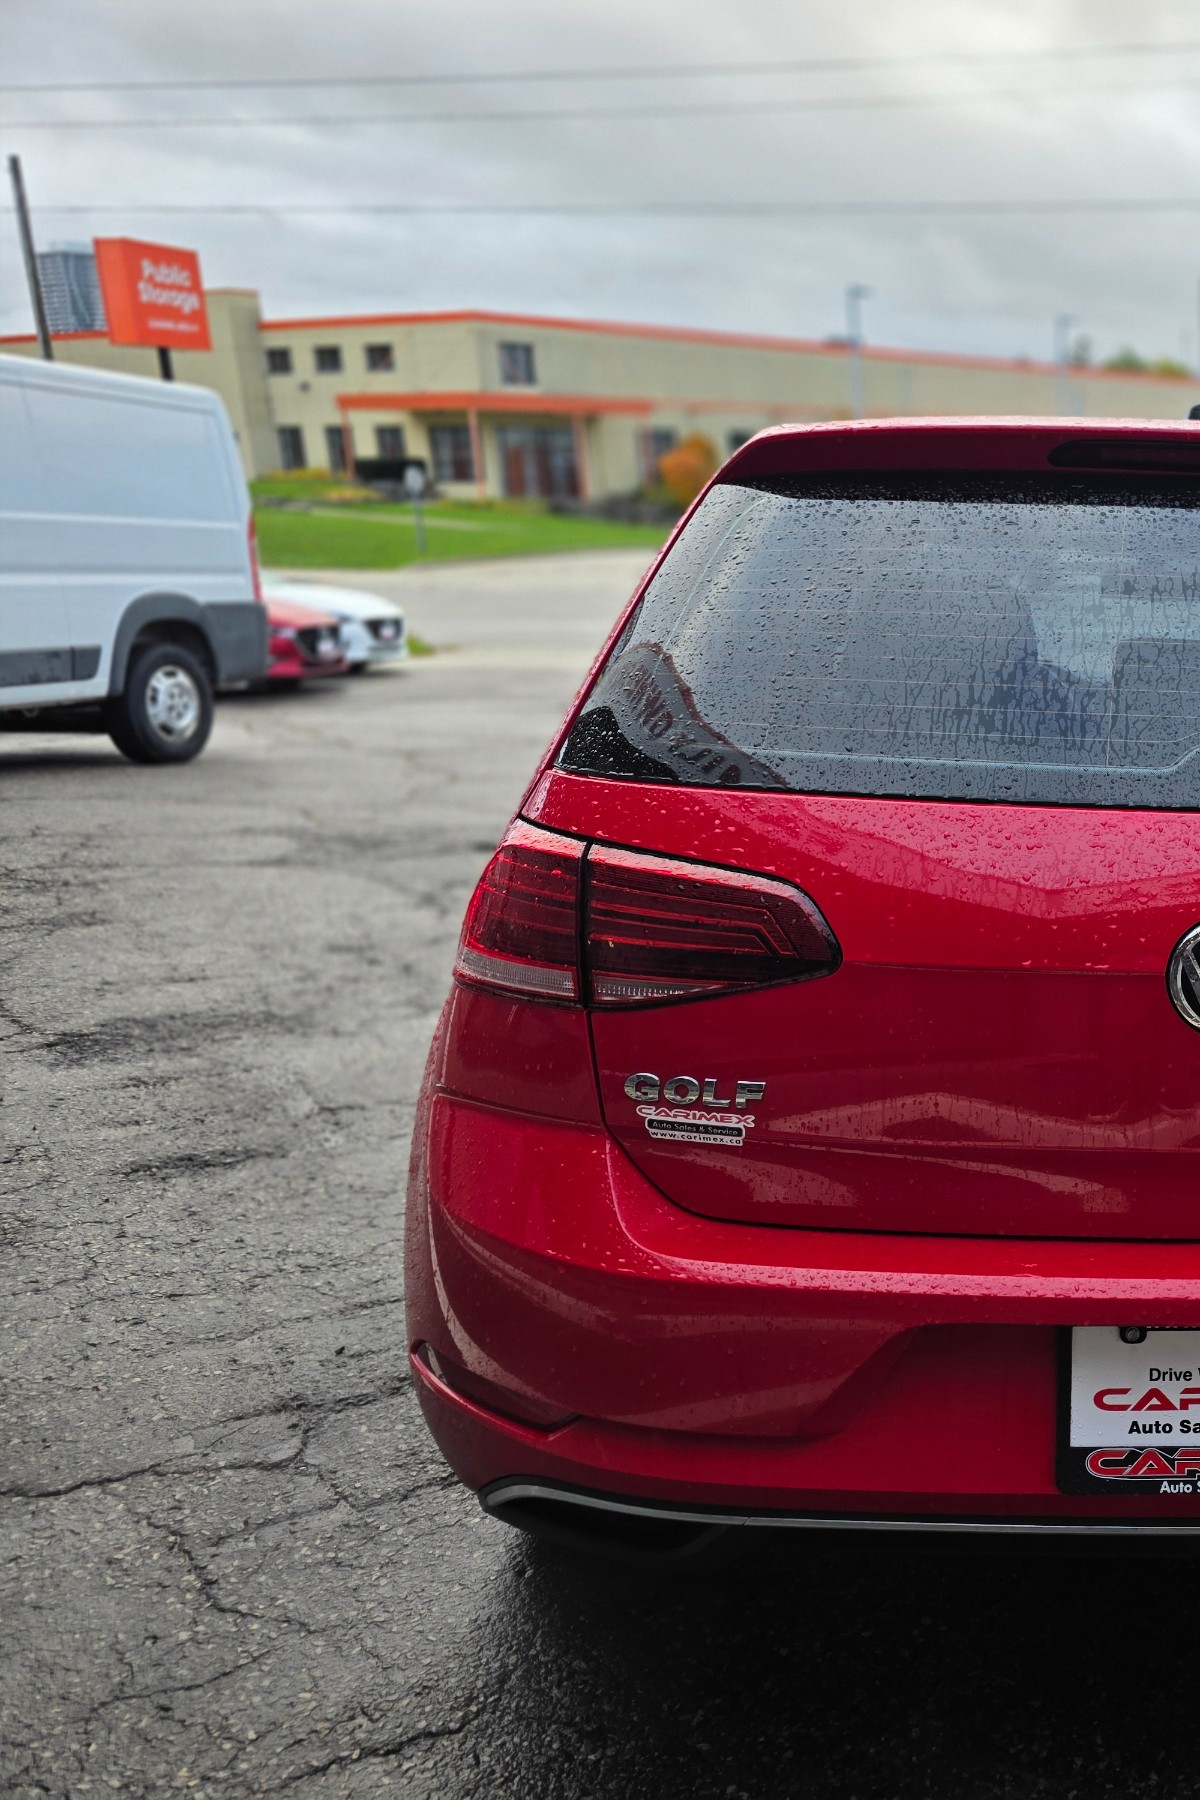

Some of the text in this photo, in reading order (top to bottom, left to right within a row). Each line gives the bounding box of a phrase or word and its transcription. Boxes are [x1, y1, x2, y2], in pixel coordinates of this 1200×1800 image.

[141, 258, 192, 288] Public
[138, 279, 200, 314] Storage
[624, 1072, 766, 1108] GOLF
[636, 1105, 756, 1127] CARIMEX
[652, 1121, 672, 1130] Auto
[674, 1123, 697, 1132] Sales
[707, 1126, 739, 1136] Service
[650, 1131, 742, 1145] www.carimex.ca
[1149, 1367, 1193, 1382] Drive
[1128, 1420, 1173, 1435] Auto
[1159, 1480, 1193, 1494] Auto
